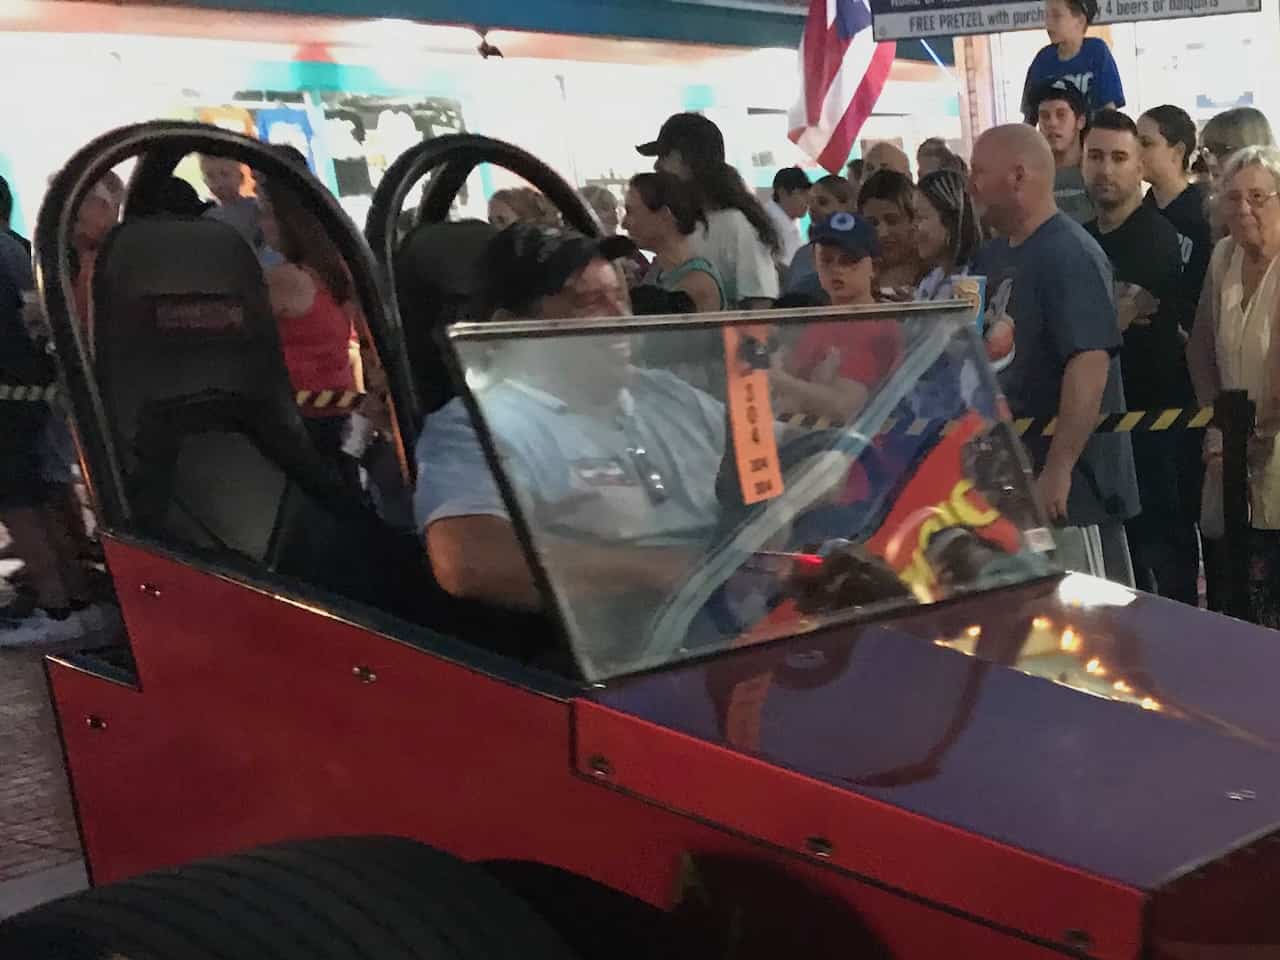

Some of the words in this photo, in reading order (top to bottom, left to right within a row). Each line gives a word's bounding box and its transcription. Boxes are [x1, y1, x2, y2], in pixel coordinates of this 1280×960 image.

[909, 14, 935, 32] FREE
[939, 10, 984, 31] PRETZEL
[988, 9, 1010, 26] with
[1013, 6, 1047, 27] purch
[1105, 3, 1112, 16] 4
[1117, 0, 1148, 16] beers
[1152, 2, 1165, 13] or
